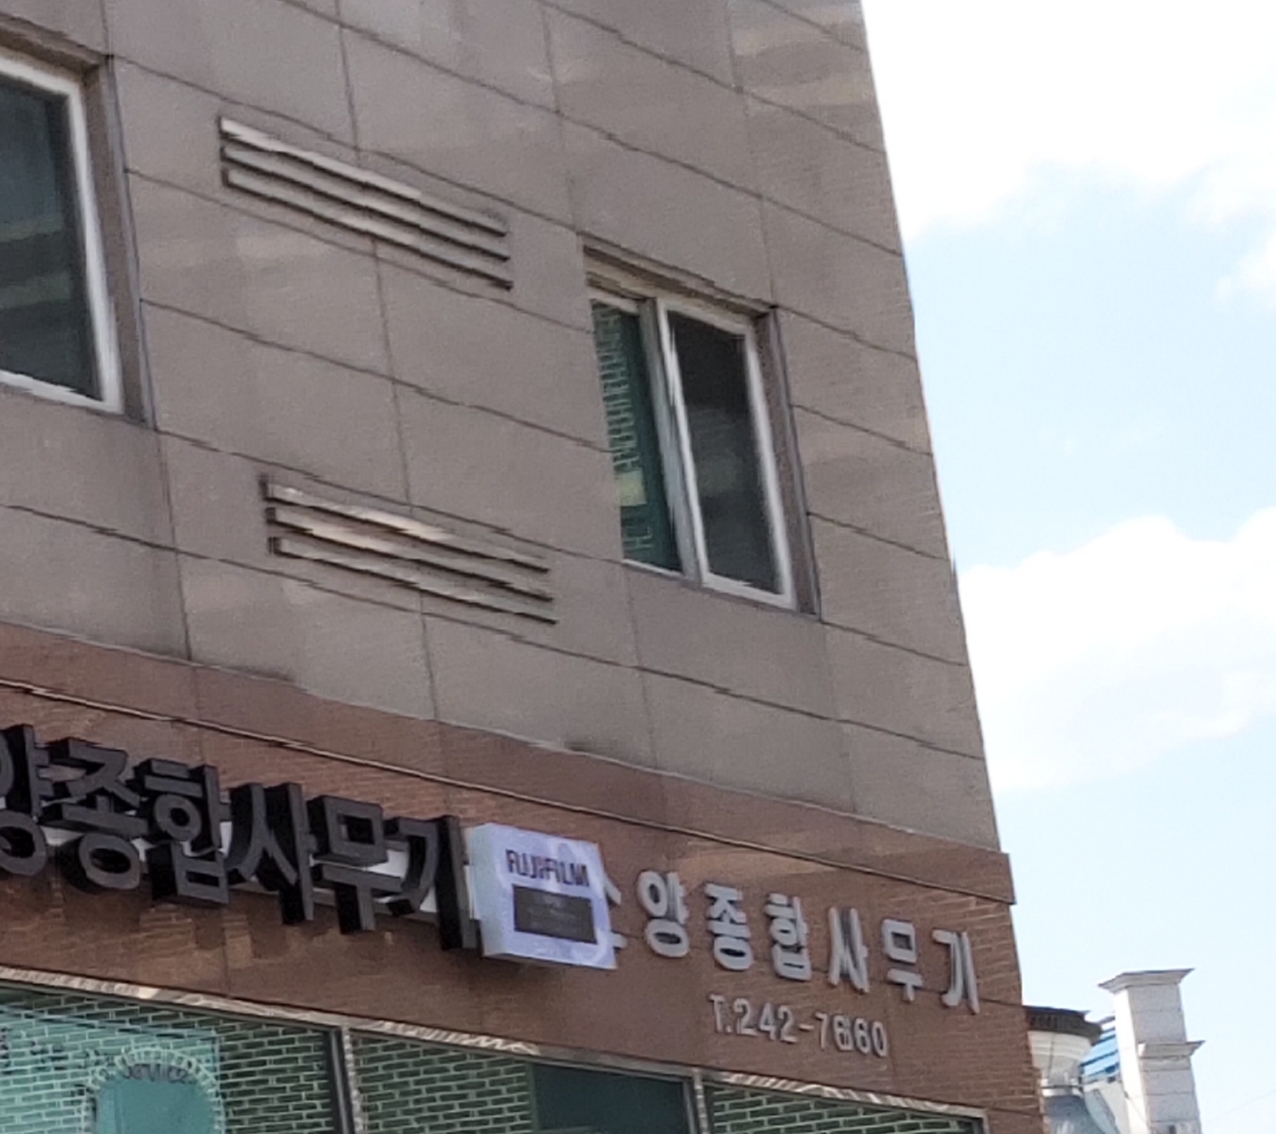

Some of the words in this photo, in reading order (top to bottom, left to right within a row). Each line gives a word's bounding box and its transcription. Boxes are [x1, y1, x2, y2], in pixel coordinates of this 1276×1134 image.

[505, 848, 591, 888] FUJIFILM
[605, 869, 981, 1014] 양종합사무기
[708, 993, 889, 1058] T.242-7660
